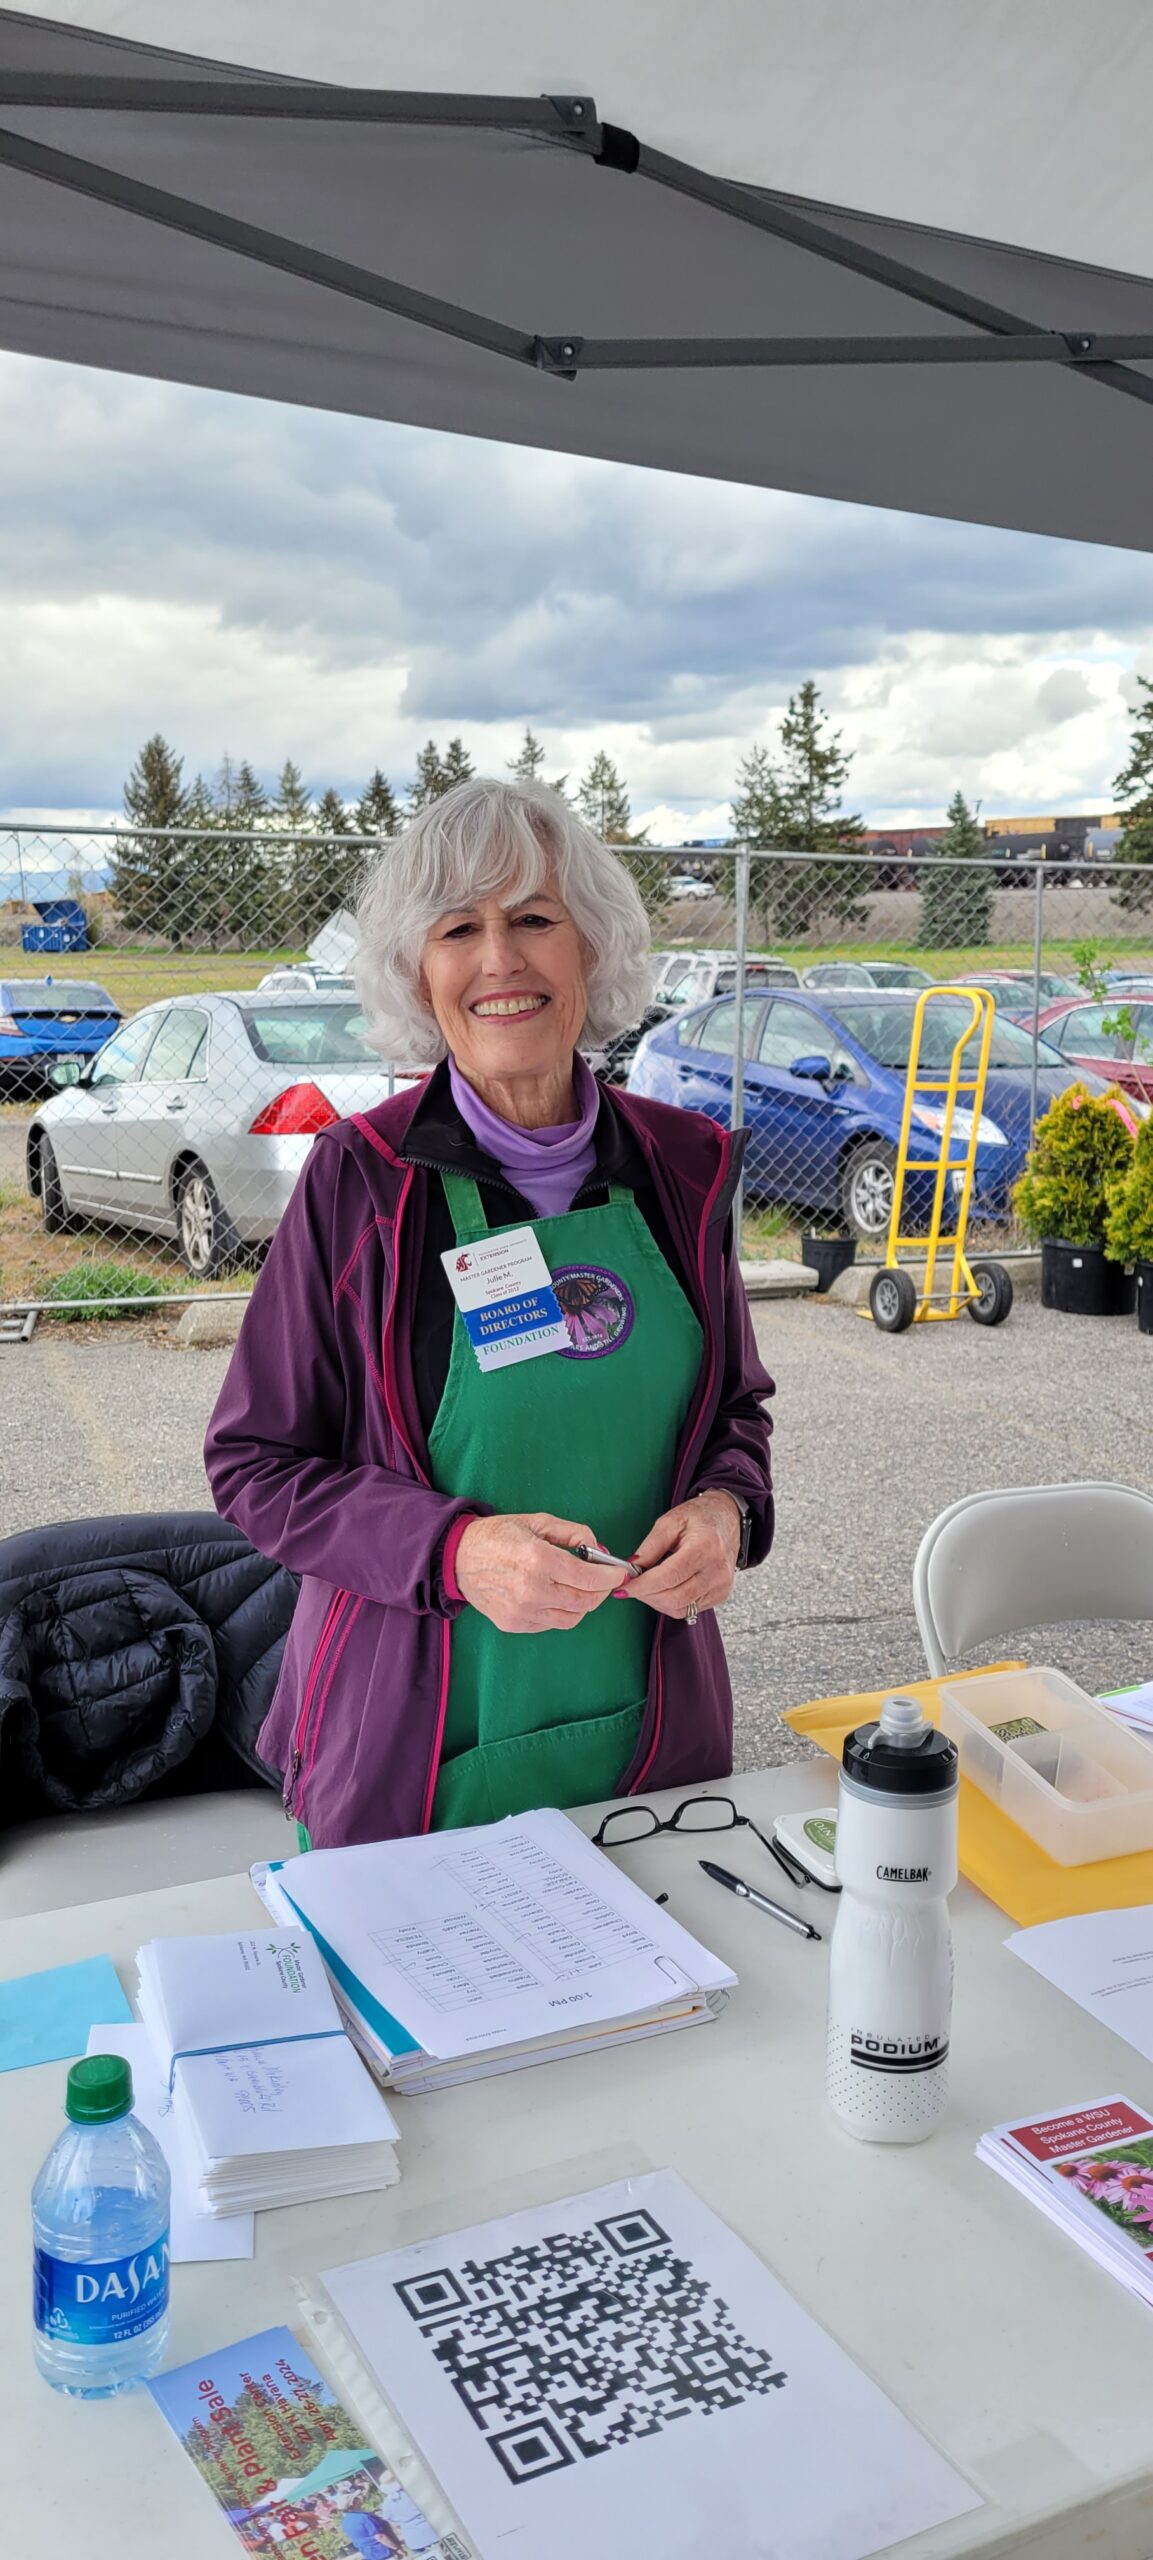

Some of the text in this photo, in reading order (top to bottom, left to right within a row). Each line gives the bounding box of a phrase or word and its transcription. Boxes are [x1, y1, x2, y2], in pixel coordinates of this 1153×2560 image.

[480, 1249, 509, 1261] EXTENSION
[460, 1256, 532, 1283] MASTER GARDENER PROGRAM
[487, 1271, 513, 1285] Julie M.
[485, 1281, 521, 1295] Spokane County
[551, 1272, 624, 1302] OUNTY MASTER GARDENERS
[480, 1296, 538, 1322] BOARD OF
[480, 1307, 548, 1336] DIRECTORS
[483, 1326, 560, 1356] FOUNDATION
[876, 1865, 929, 1882] CAMELBAK
[282, 1954, 301, 1993] FOUNDATION
[548, 1991, 593, 2008] 1:00 PM
[851, 2027, 930, 2042] INSULATED
[851, 2033, 938, 2055] PODIUM
[1031, 2108, 1111, 2136] Become a WSU
[1039, 2116, 1124, 2146] Spokane County
[1048, 2125, 1135, 2154] Master Gardener
[76, 2243, 170, 2304] DASAN
[111, 2303, 146, 2321] PURIFIED
[113, 2331, 123, 2340] 12
[123, 2328, 132, 2337] FL
[133, 2323, 142, 2333] OZ
[275, 2358, 300, 2385] 2024
[198, 2379, 232, 2422] Sale
[262, 2374, 313, 2443] 222 N Havana
[238, 2372, 301, 2461] Extension Center
[312, 2416, 338, 2441] April
[192, 2416, 214, 2449] Program
[222, 2422, 267, 2478] Plant
[211, 2450, 237, 2487] Gardener
[256, 2477, 277, 2495] &
[268, 2499, 307, 2539] Fair
